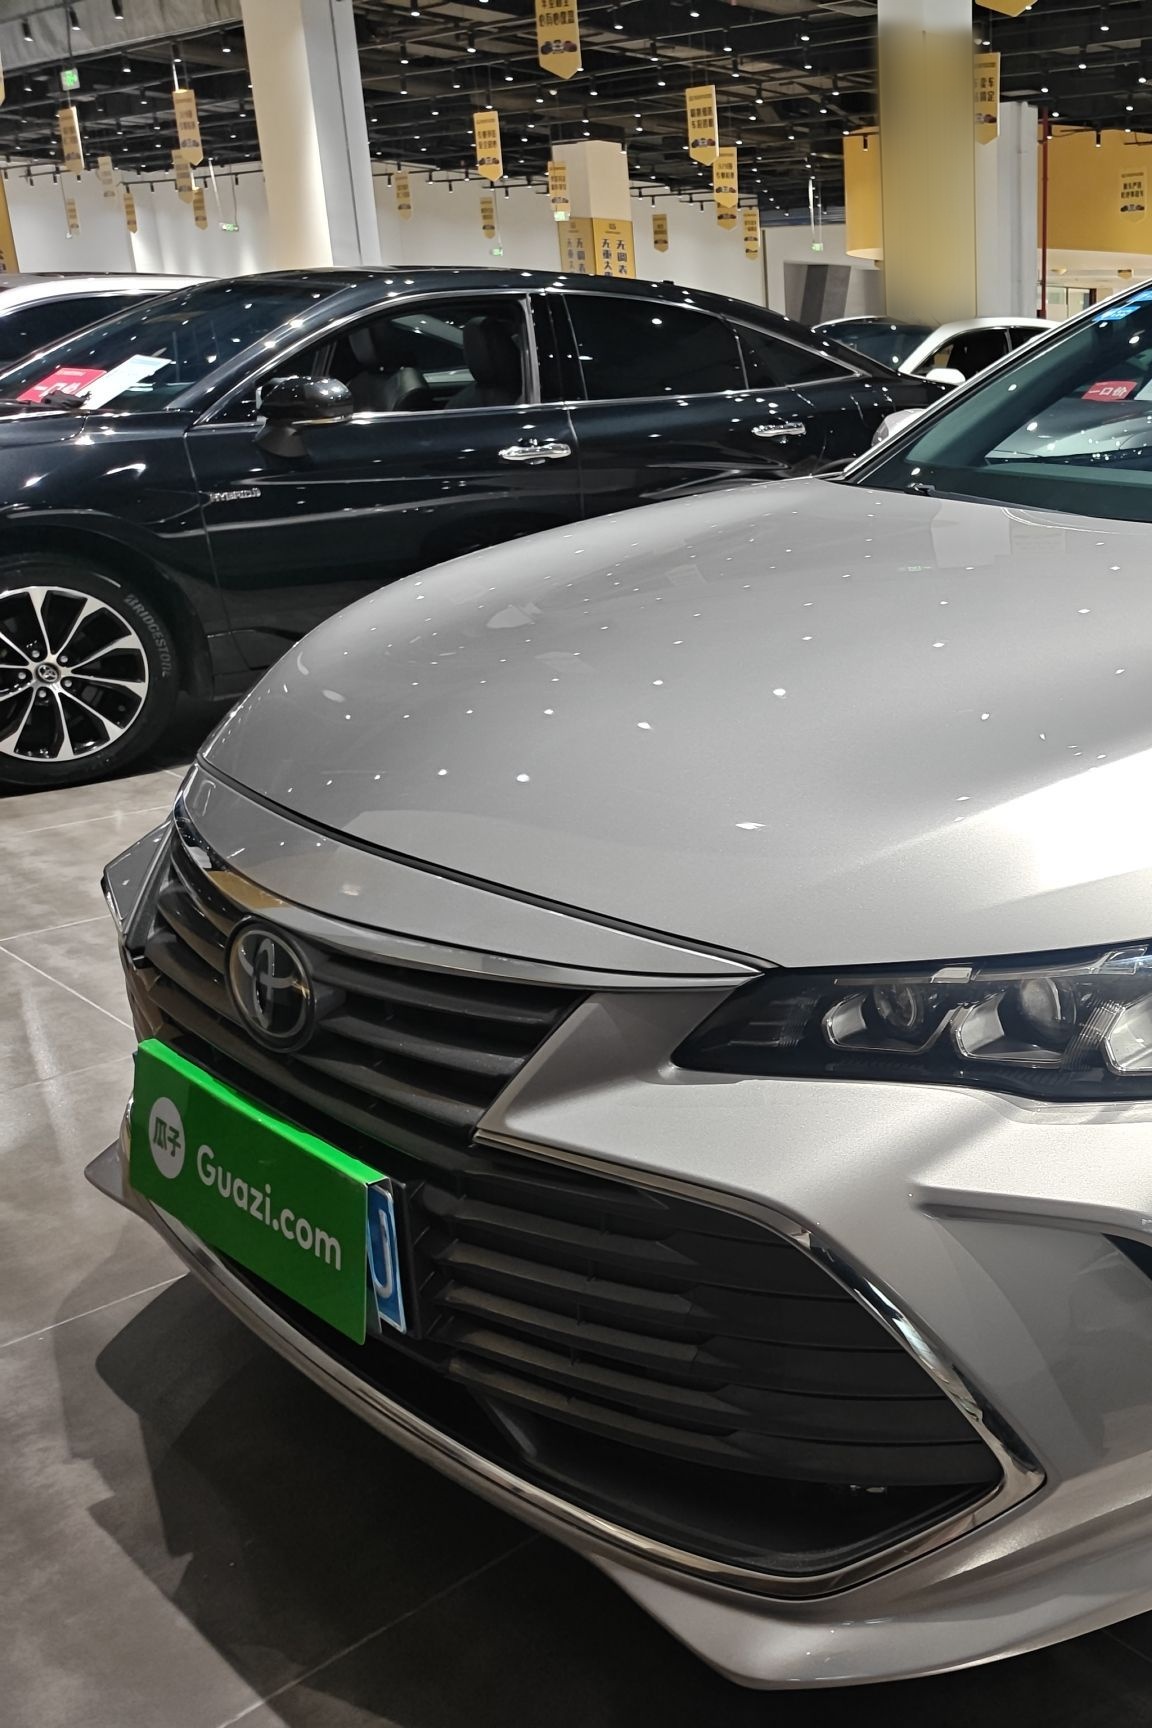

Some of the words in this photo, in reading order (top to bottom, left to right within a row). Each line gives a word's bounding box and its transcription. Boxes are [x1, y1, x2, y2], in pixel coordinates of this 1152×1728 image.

[1088, 386, 1128, 397] 一口价
[210, 487, 261, 502] HYBRID
[153, 1116, 181, 1158] 瓜子
[196, 1144, 342, 1272] Guazi.com
